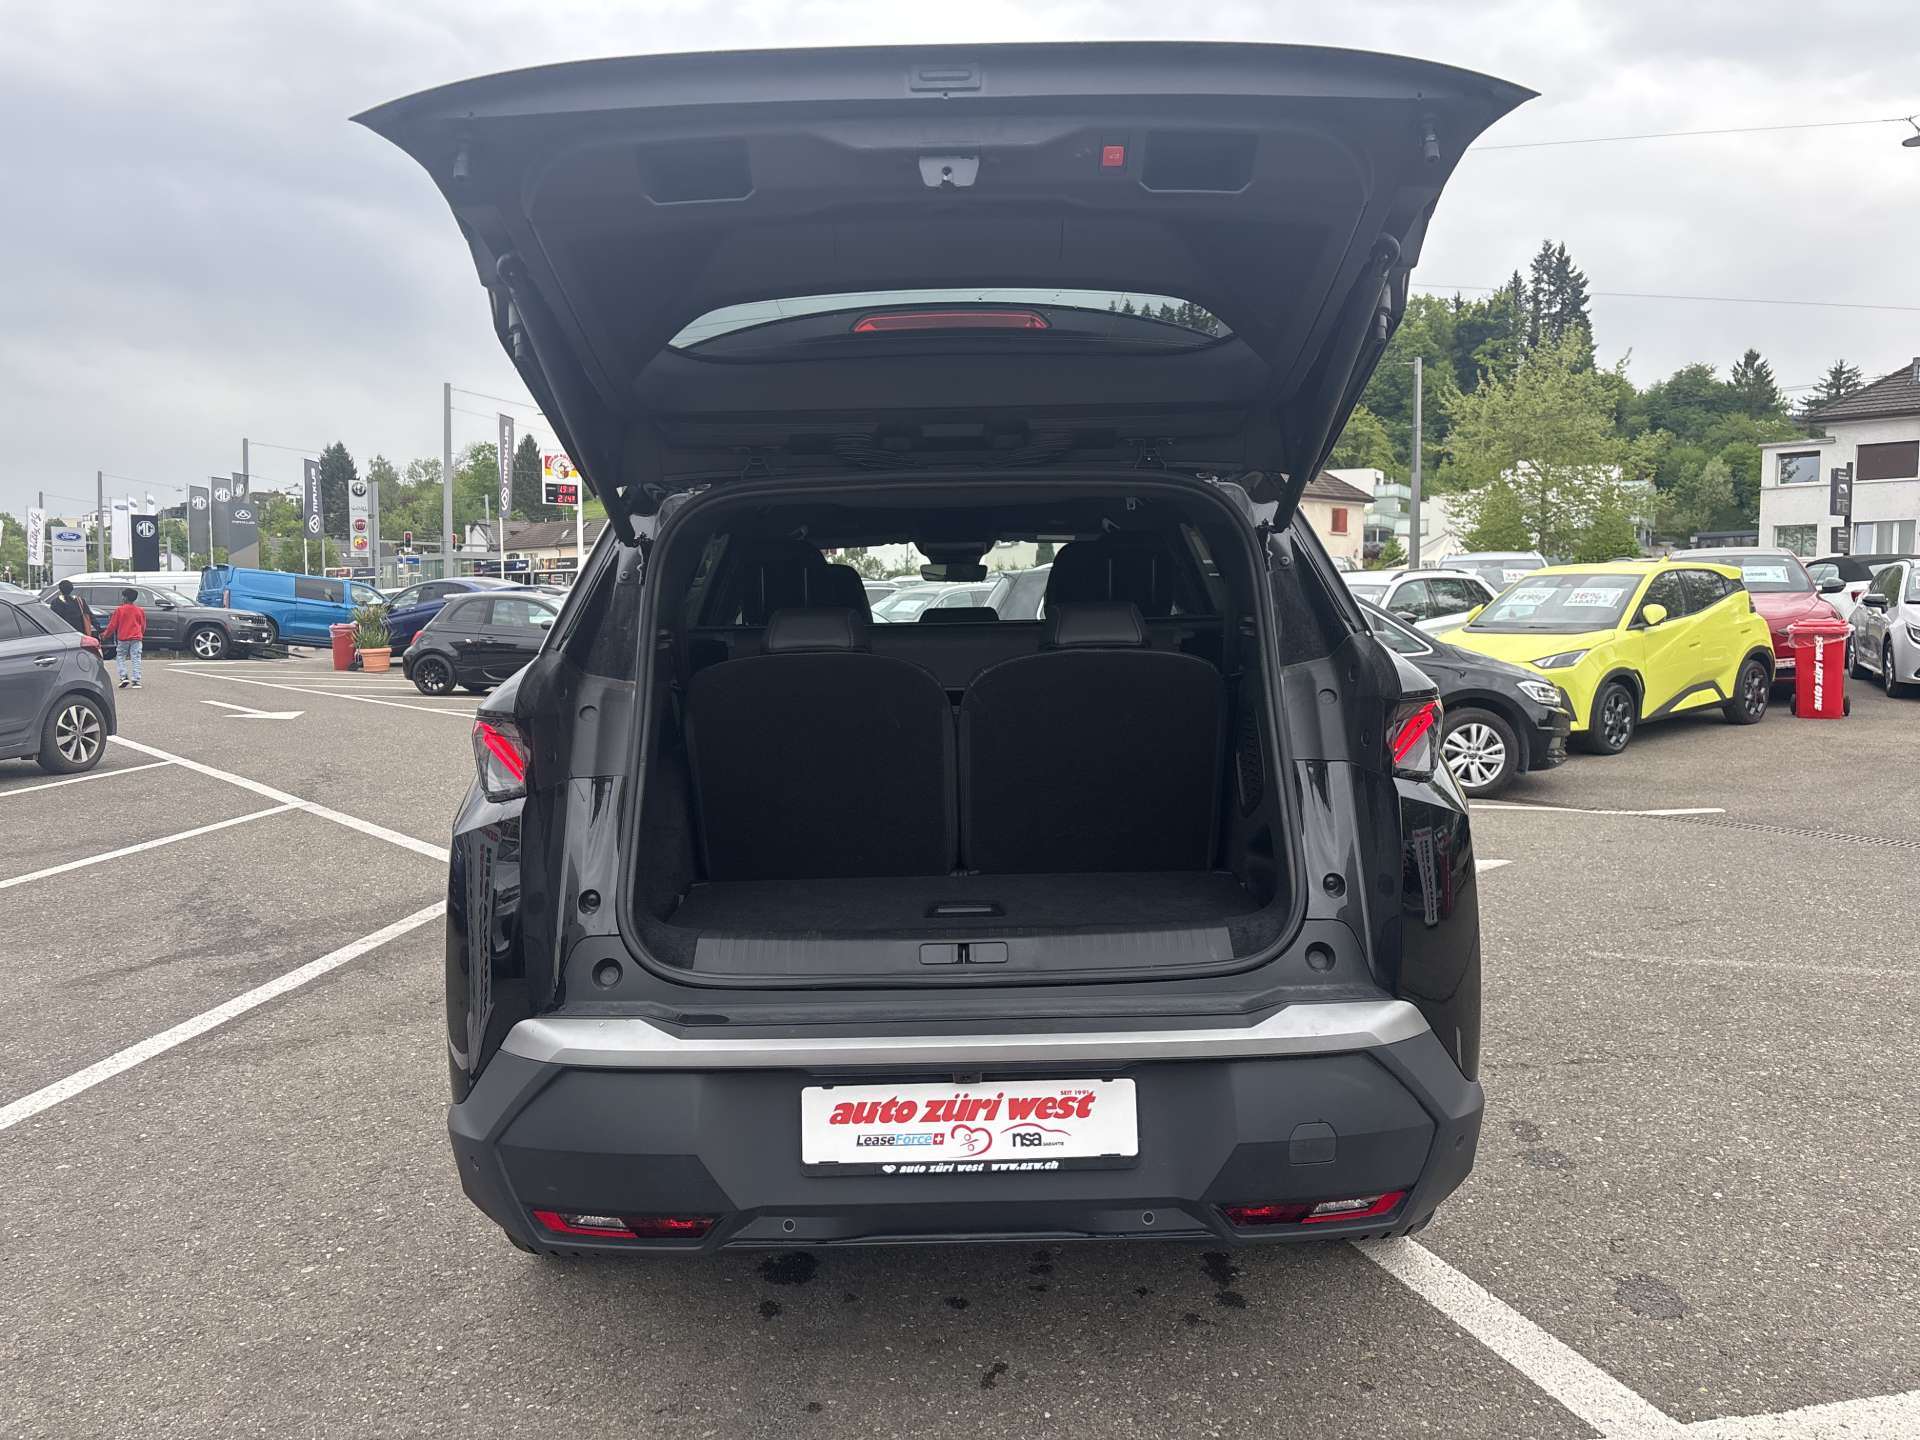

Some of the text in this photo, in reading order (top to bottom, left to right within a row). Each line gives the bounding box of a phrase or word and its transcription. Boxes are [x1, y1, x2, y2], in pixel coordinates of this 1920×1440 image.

[214, 488, 231, 502] MG
[136, 521, 155, 537] MG
[1814, 685, 1823, 711] auto
[829, 1091, 1096, 1124] auto züri west
[857, 1133, 932, 1147] LeaseForce
[1012, 1132, 1042, 1147] nsa
[900, 1164, 925, 1173] auto
[928, 1163, 954, 1173] züri
[958, 1163, 984, 1172] west
